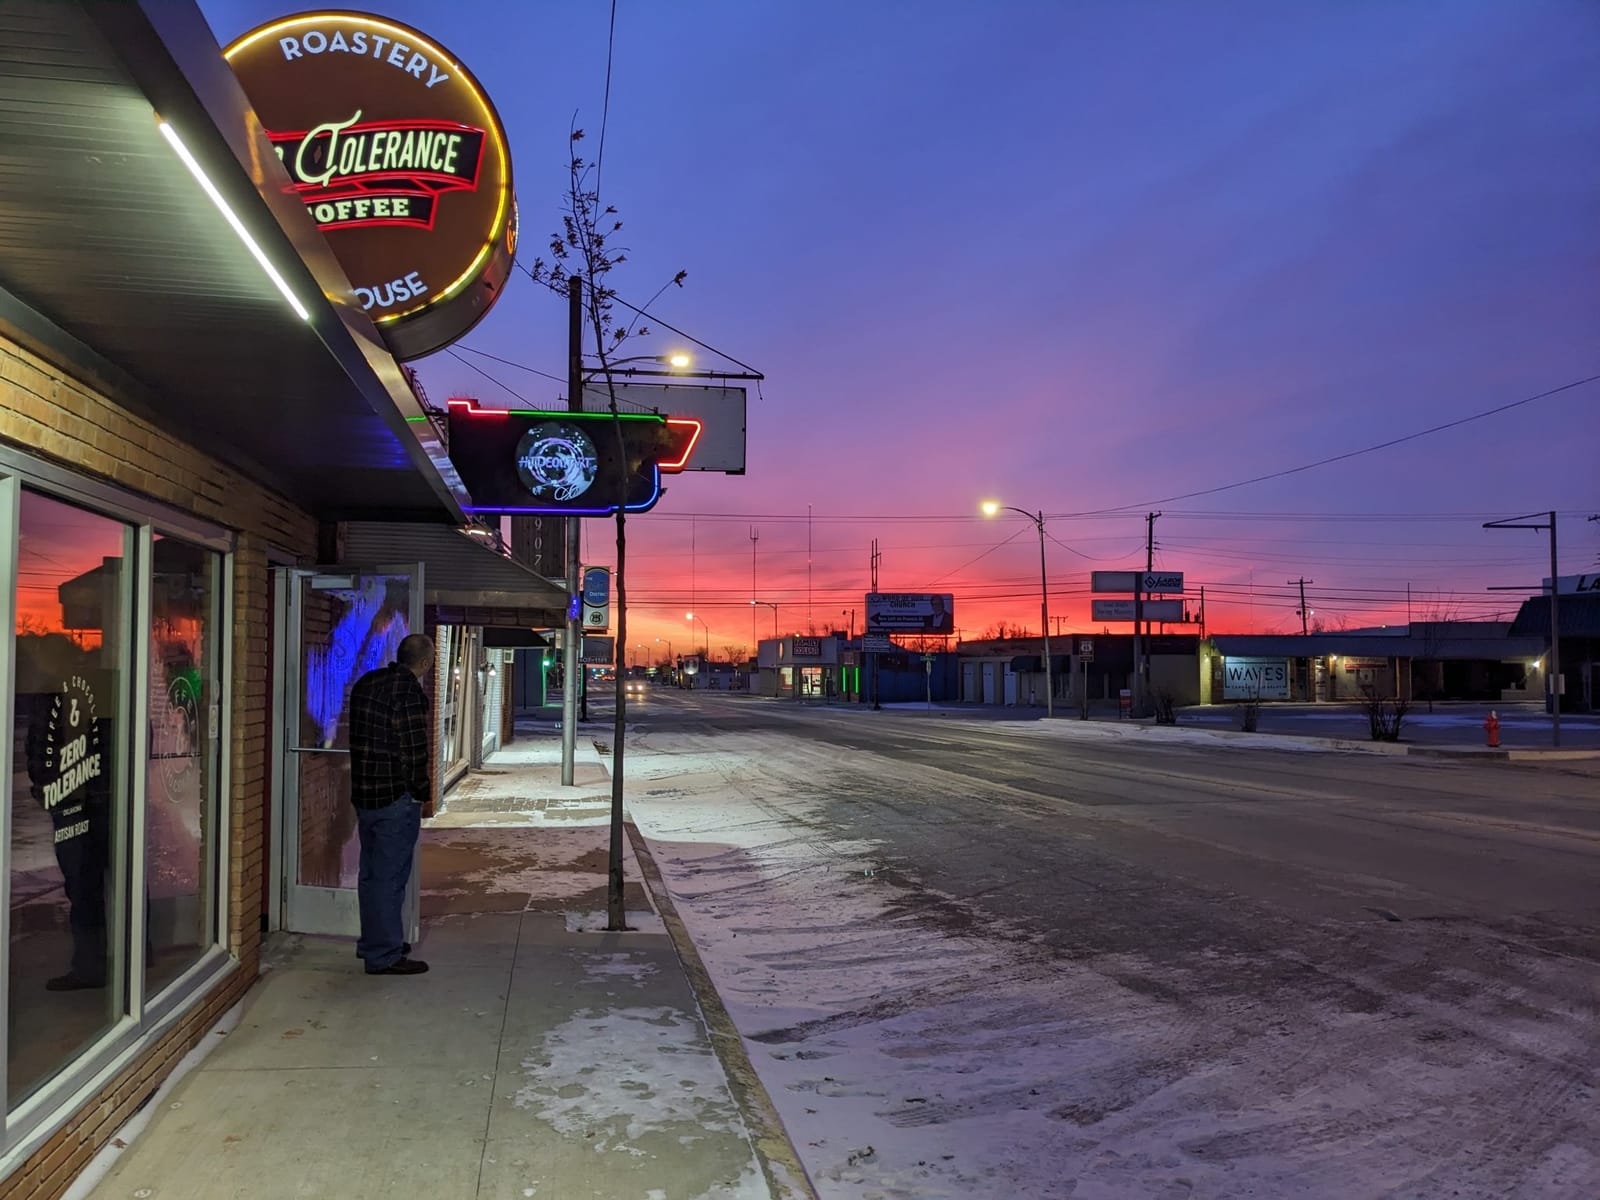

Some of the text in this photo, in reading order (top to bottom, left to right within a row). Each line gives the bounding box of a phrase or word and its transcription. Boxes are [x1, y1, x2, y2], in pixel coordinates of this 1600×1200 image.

[279, 30, 449, 89] ROASTERY
[295, 109, 462, 187] TOLERANCE
[307, 197, 410, 223] OFFEE
[1228, 667, 1284, 681] WAVES
[45, 695, 62, 768] COFFEE
[71, 675, 100, 745] CHOCOLATE
[59, 733, 87, 773] ZERO
[42, 752, 102, 810] TOLERANCE
[54, 819, 90, 844] ARTISAN ROAST
